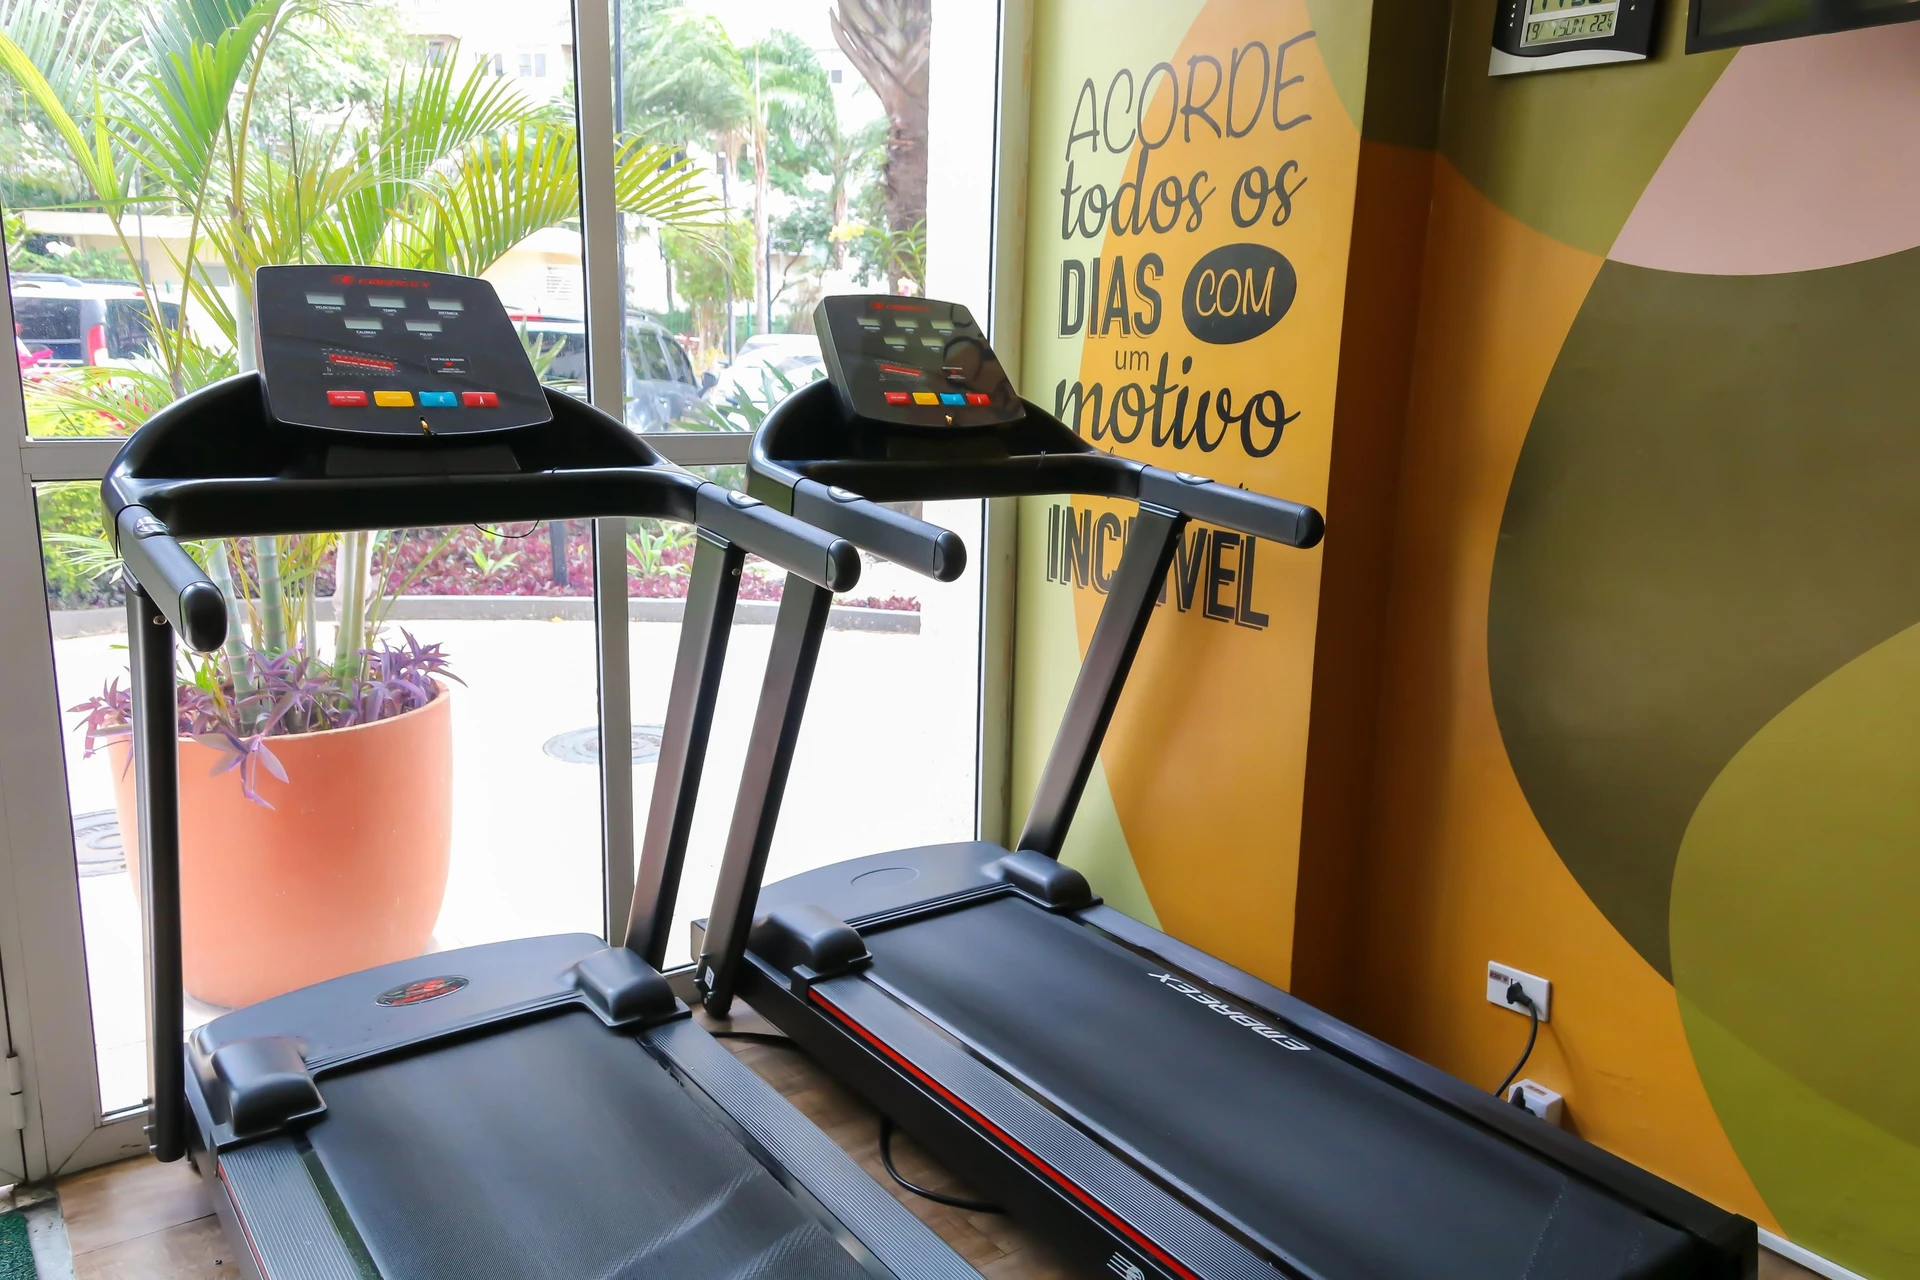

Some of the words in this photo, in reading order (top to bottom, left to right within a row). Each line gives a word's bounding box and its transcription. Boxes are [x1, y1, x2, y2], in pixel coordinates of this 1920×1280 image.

[1065, 30, 1317, 162] ACORDE
[1060, 147, 1216, 240] todos
[1231, 160, 1308, 228] os
[1058, 253, 1164, 339] DIAS
[1195, 266, 1276, 317] COM
[1055, 352, 1302, 458] motivo
[1115, 350, 1149, 371] um
[1046, 504, 1270, 631] INCVEL
[1148, 972, 1311, 1051] EMBREEX
